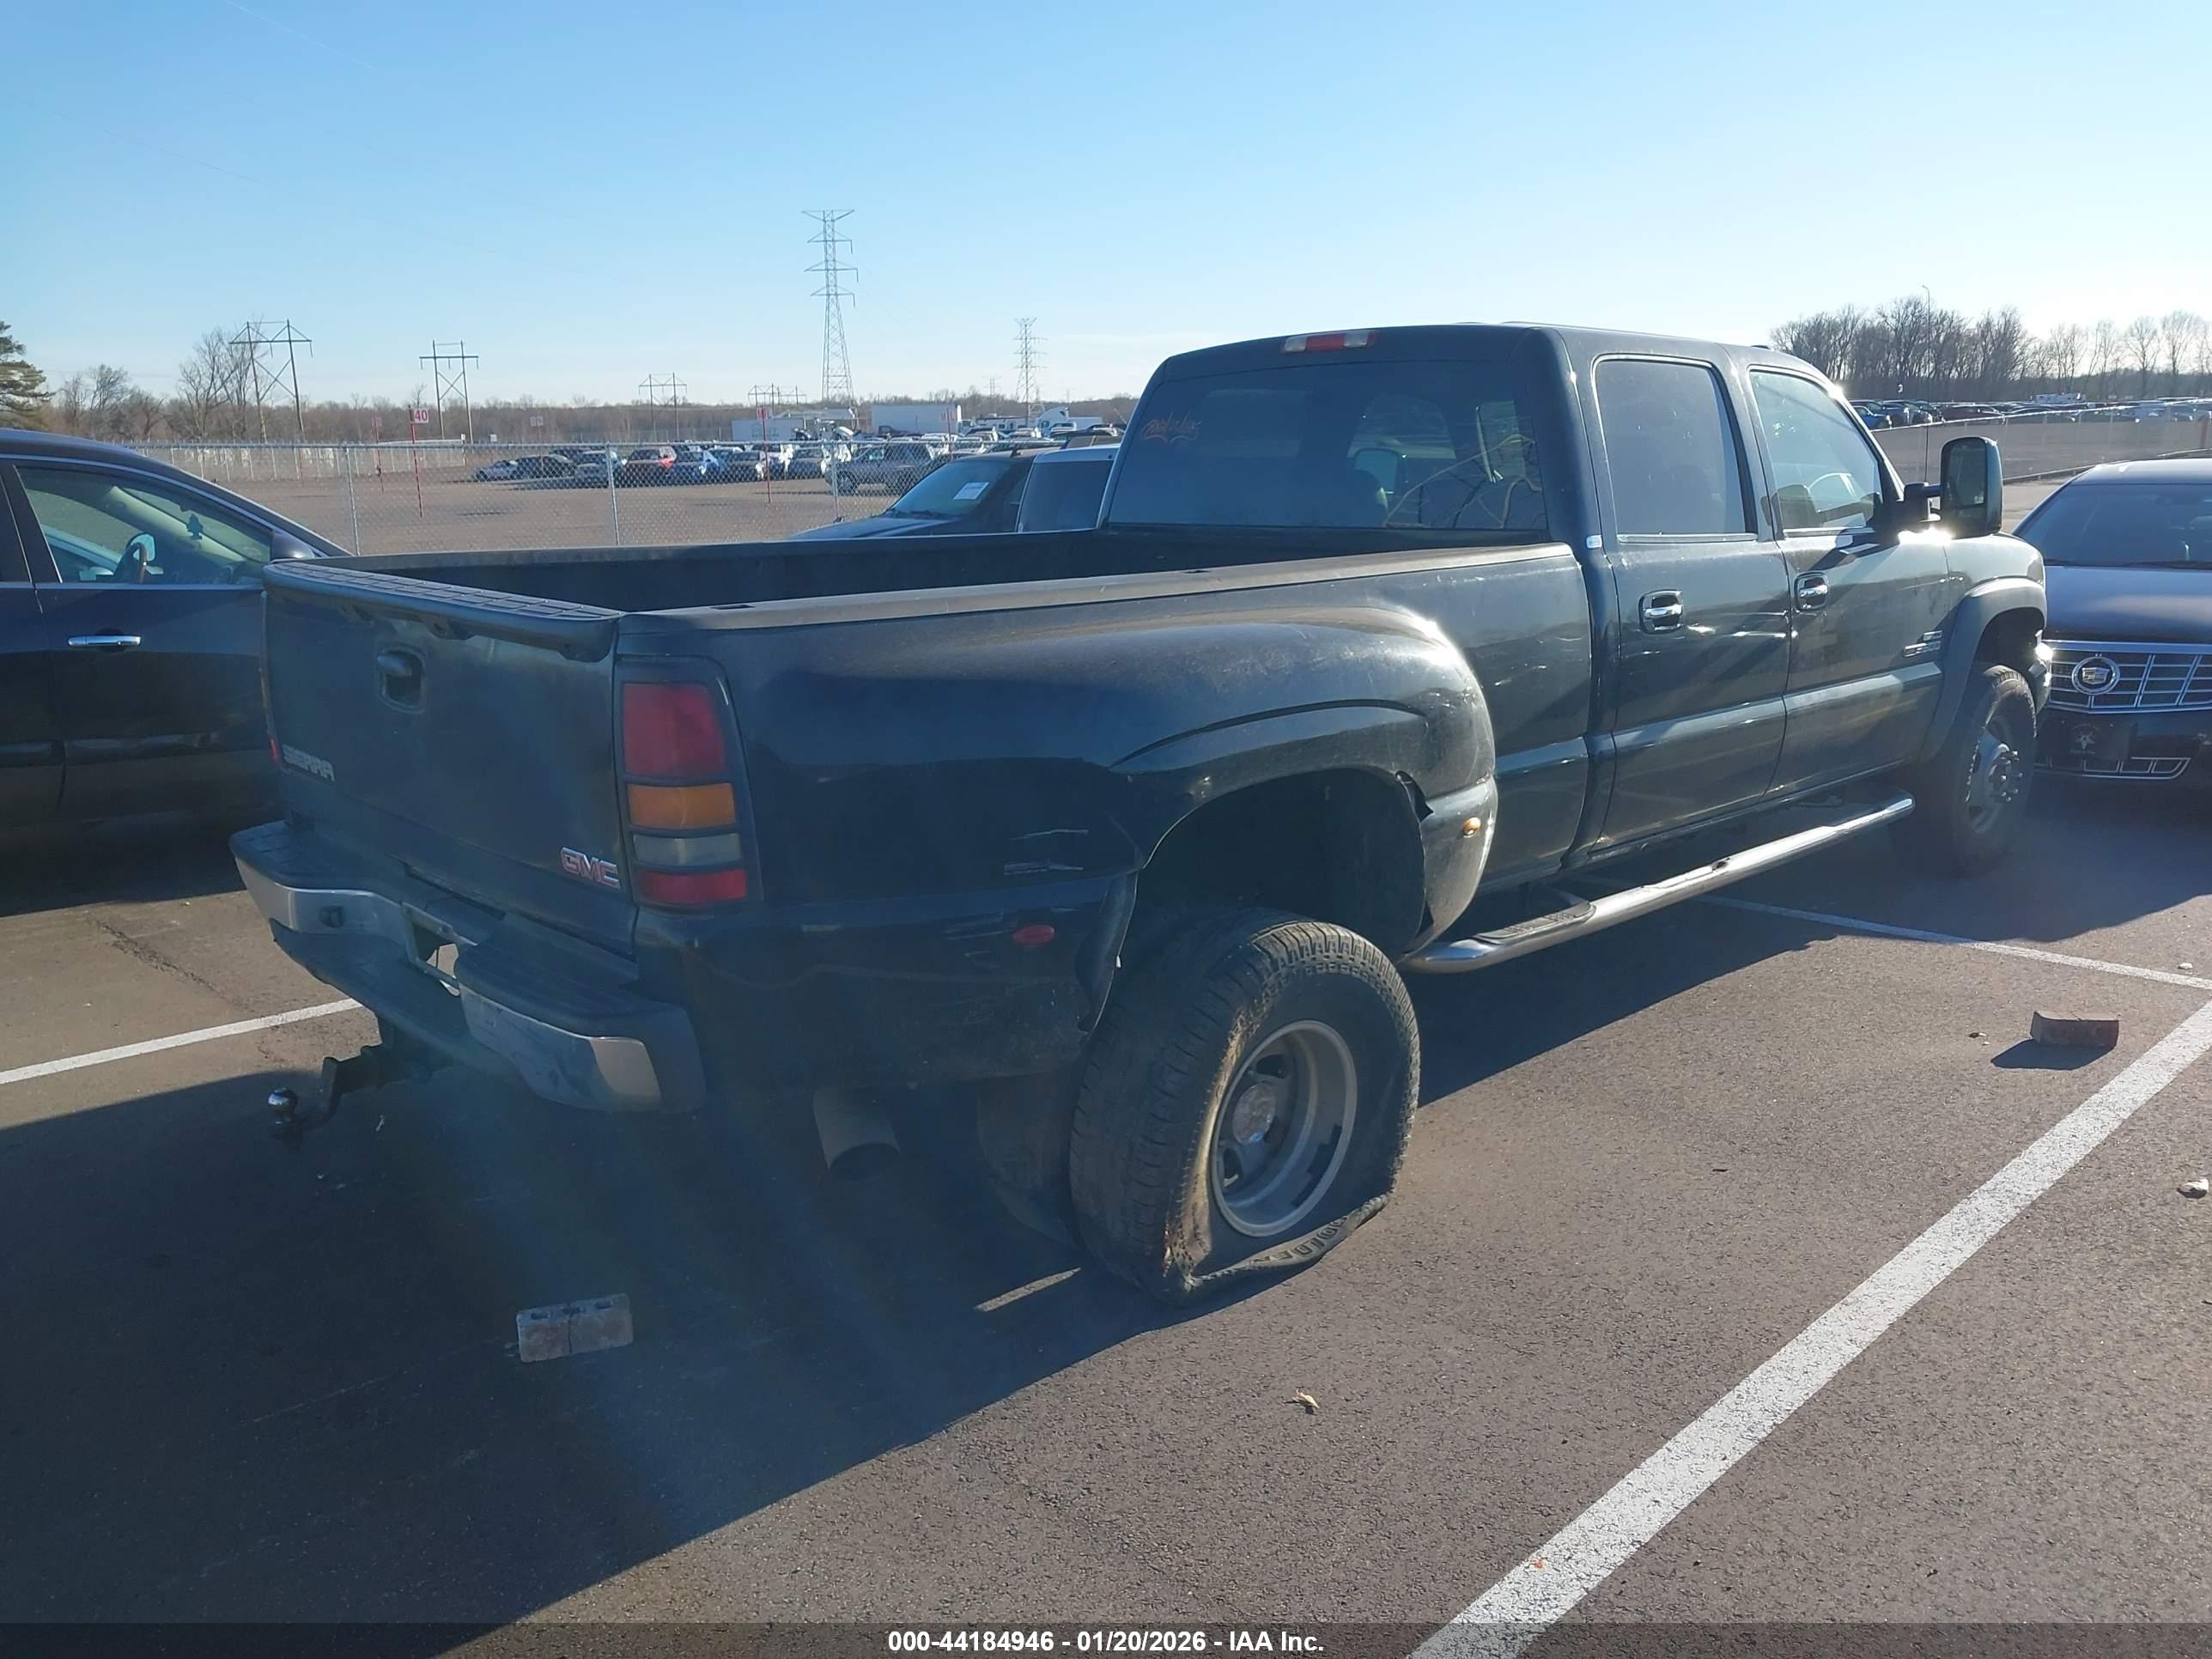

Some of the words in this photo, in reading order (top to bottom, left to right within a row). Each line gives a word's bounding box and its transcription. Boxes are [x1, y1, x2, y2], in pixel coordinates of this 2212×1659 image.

[415, 410, 428, 422] 40
[282, 744, 335, 781] SIERRA
[560, 847, 620, 889] GMC
